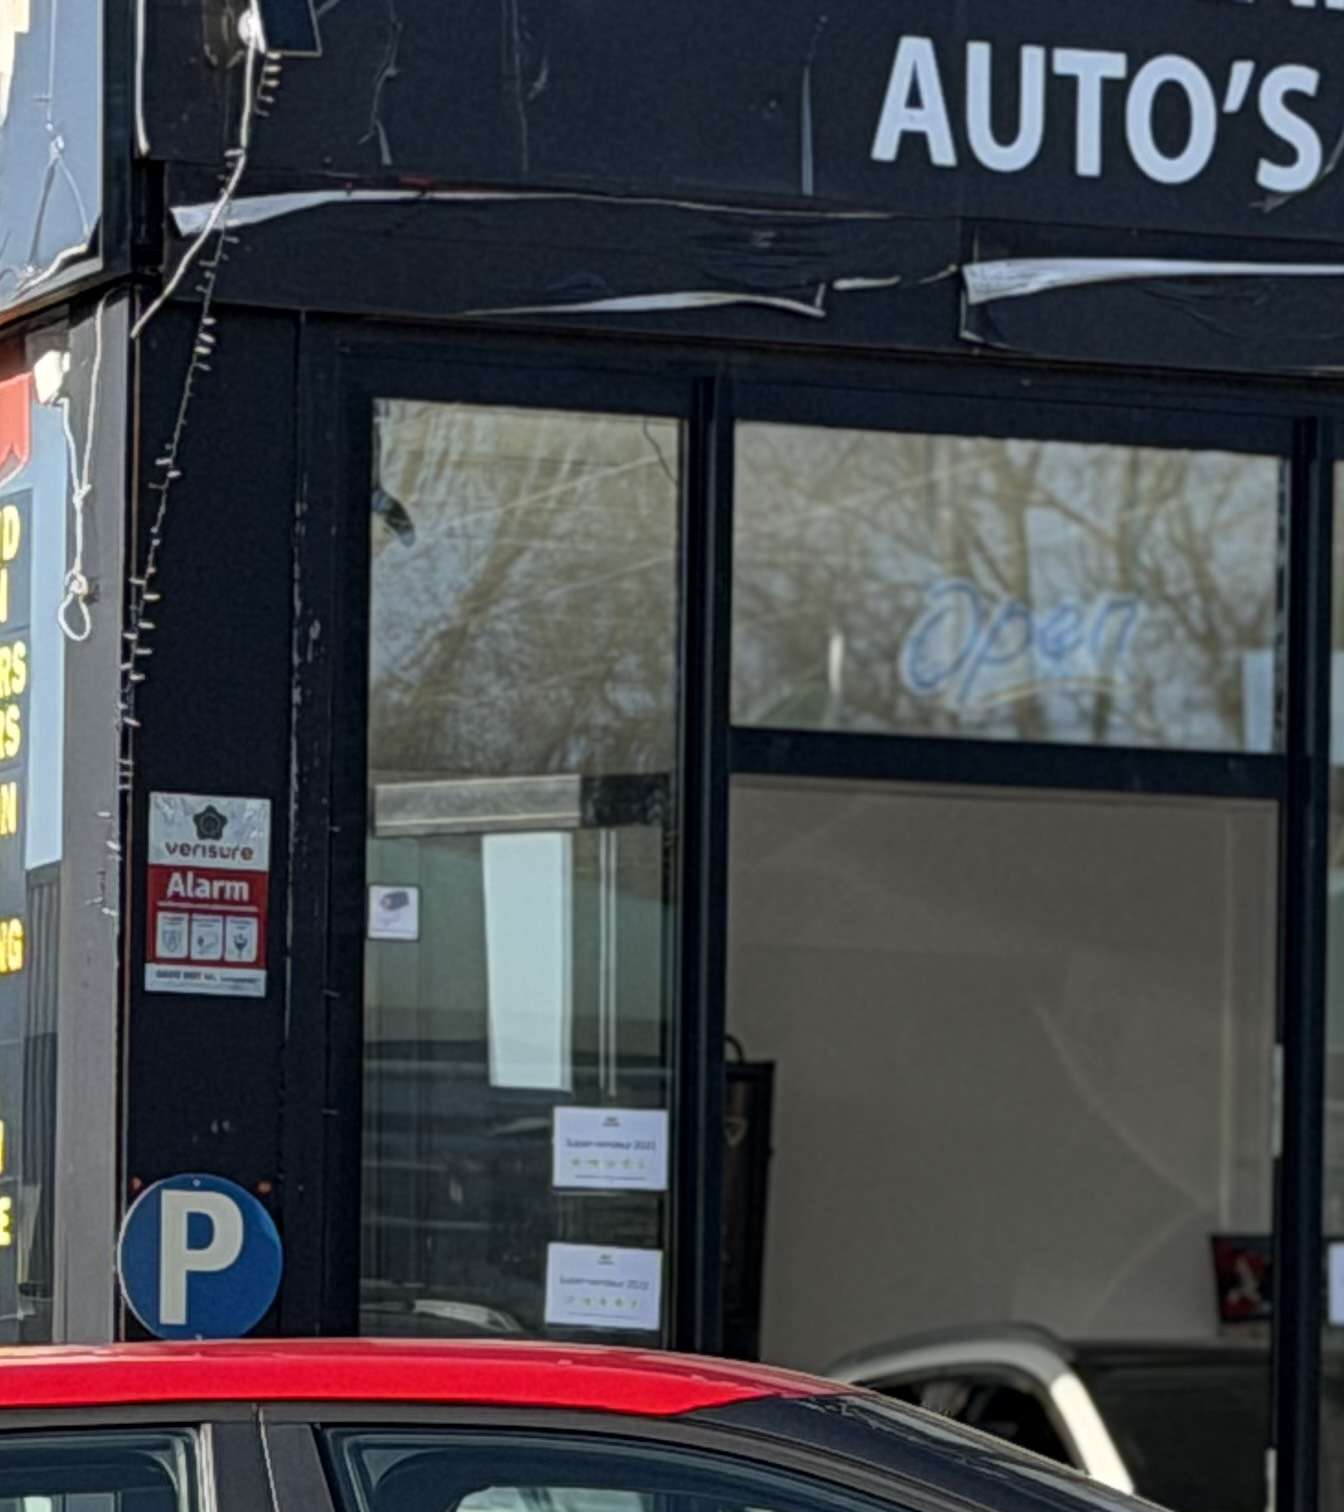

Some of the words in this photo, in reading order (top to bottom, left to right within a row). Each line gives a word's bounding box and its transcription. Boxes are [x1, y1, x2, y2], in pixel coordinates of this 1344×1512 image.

[900, 578, 1142, 700] Open
[164, 841, 254, 862] verisure
[166, 871, 250, 902] Alarm
[159, 1190, 244, 1325] P
